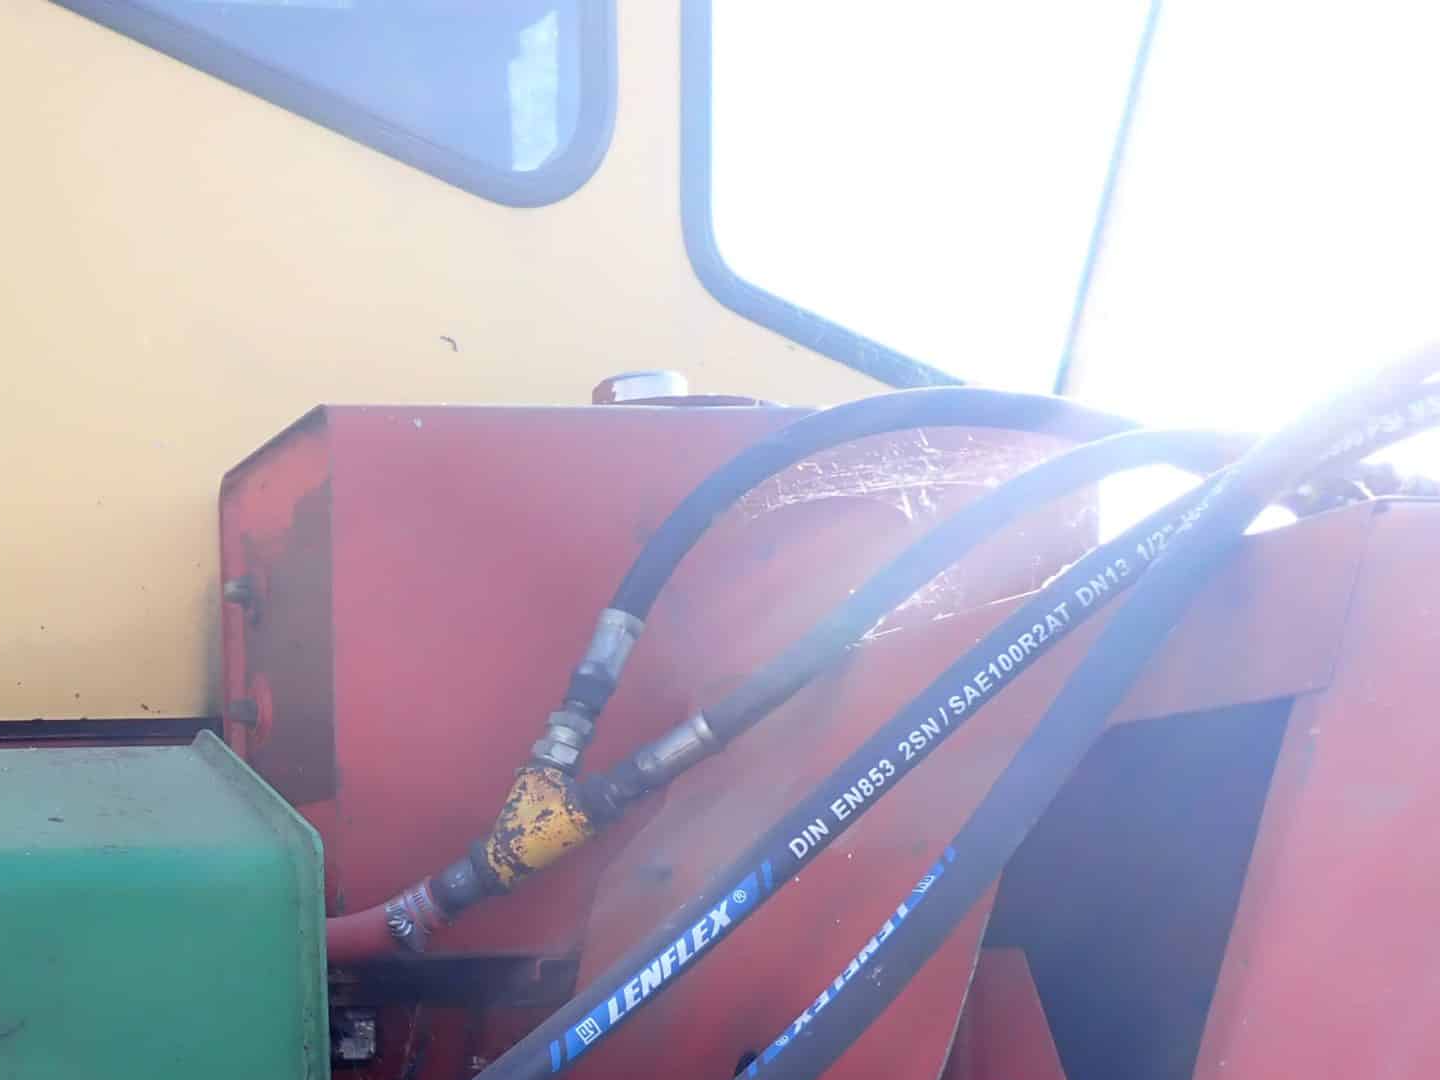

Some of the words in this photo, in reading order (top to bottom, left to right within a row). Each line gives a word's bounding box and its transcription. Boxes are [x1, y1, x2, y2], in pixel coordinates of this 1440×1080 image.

[788, 818, 830, 859] DIN
[830, 759, 895, 821] EN853
[1075, 558, 1132, 607] DN13
[608, 899, 732, 1024] LENFLEX
